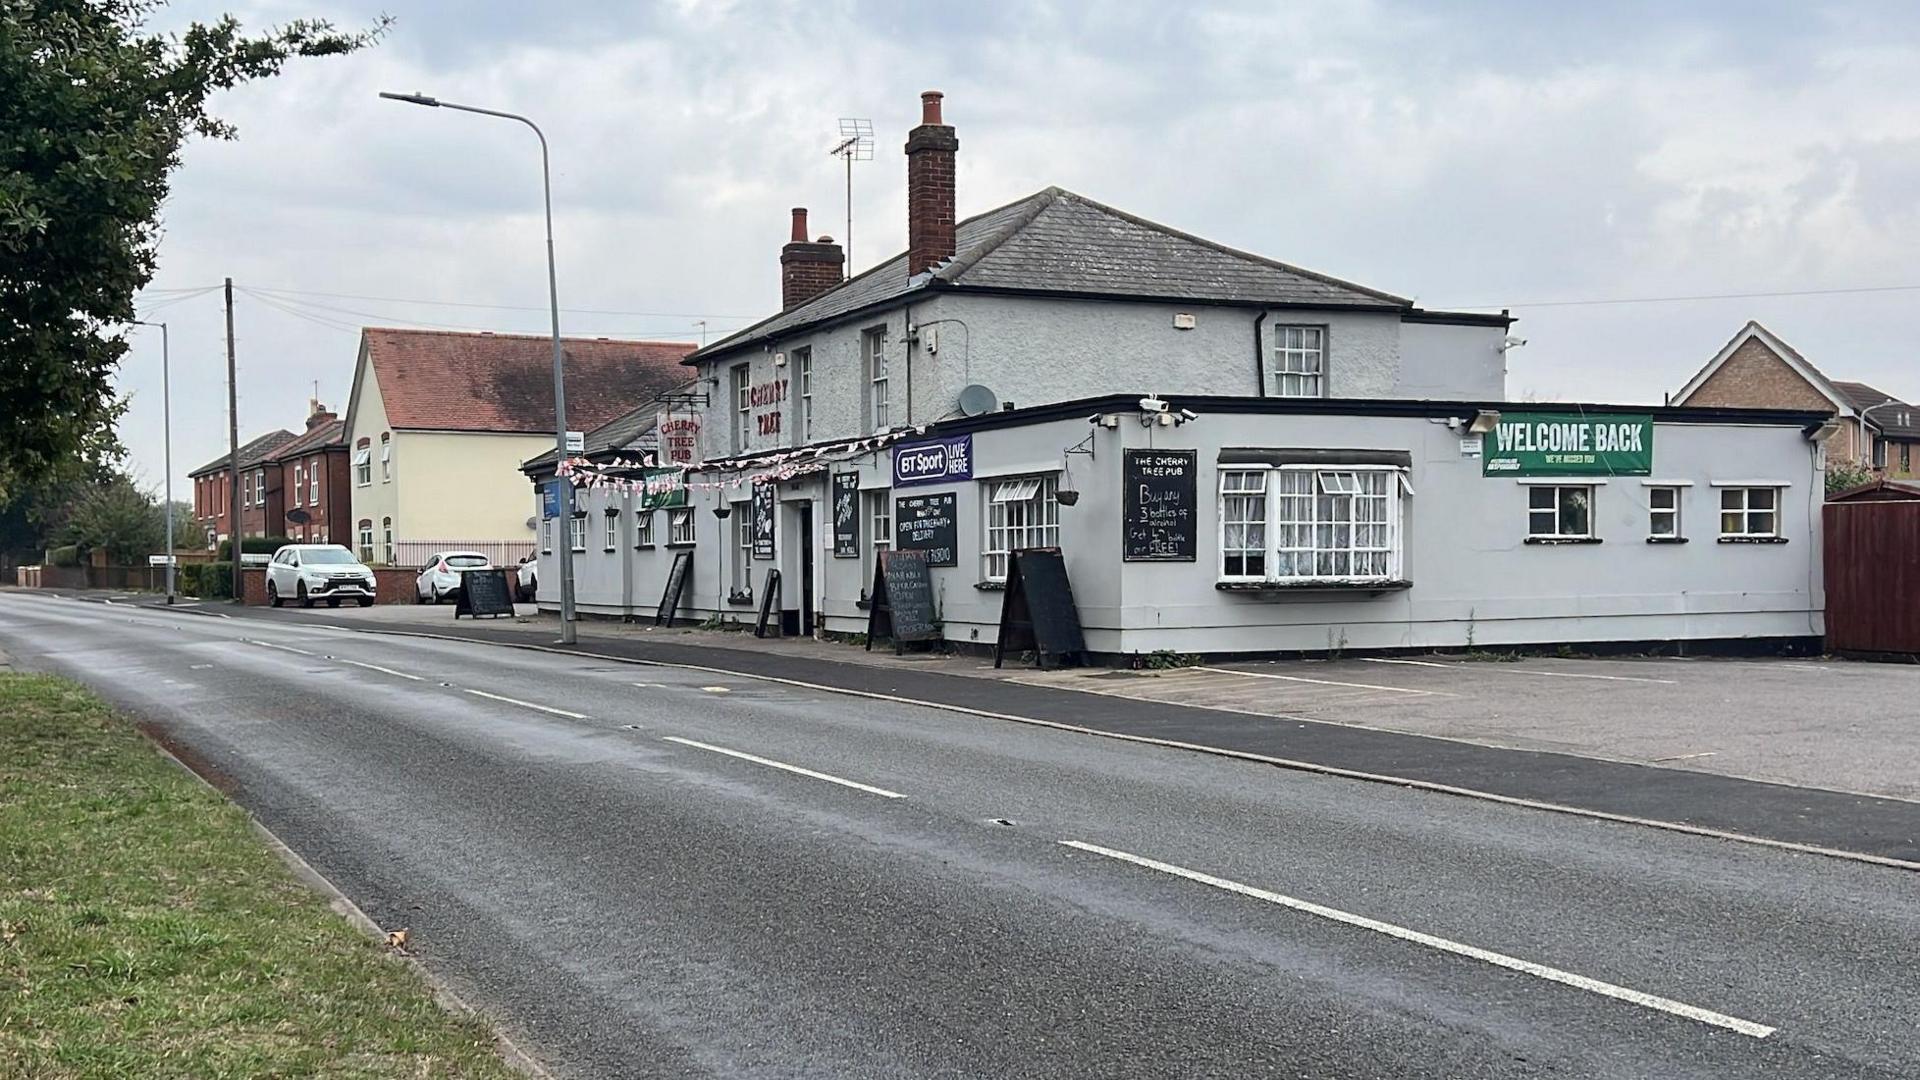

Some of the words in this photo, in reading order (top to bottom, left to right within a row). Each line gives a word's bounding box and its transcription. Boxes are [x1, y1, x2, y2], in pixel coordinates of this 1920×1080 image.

[751, 379, 788, 407] CHERRY
[661, 419, 701, 435] CHERRY
[757, 411, 781, 436] TREE
[668, 437, 695, 447] TREE
[1496, 423, 1590, 451] WELCOME
[1595, 424, 1643, 451] BACK
[671, 450, 692, 461] PUB
[948, 443, 966, 459] LIVE
[901, 456, 916, 473] BT
[917, 451, 943, 474] Sport
[949, 457, 968, 474] HERE
[1134, 457, 1152, 466] THE
[1155, 457, 1188, 466] CHERRY
[1584, 454, 1596, 463] YOU
[1142, 467, 1164, 476] TREE
[1165, 467, 1183, 476] PUB
[1140, 506, 1149, 520] 3
[1130, 527, 1147, 540] Get
[1149, 542, 1179, 553] FREE!
